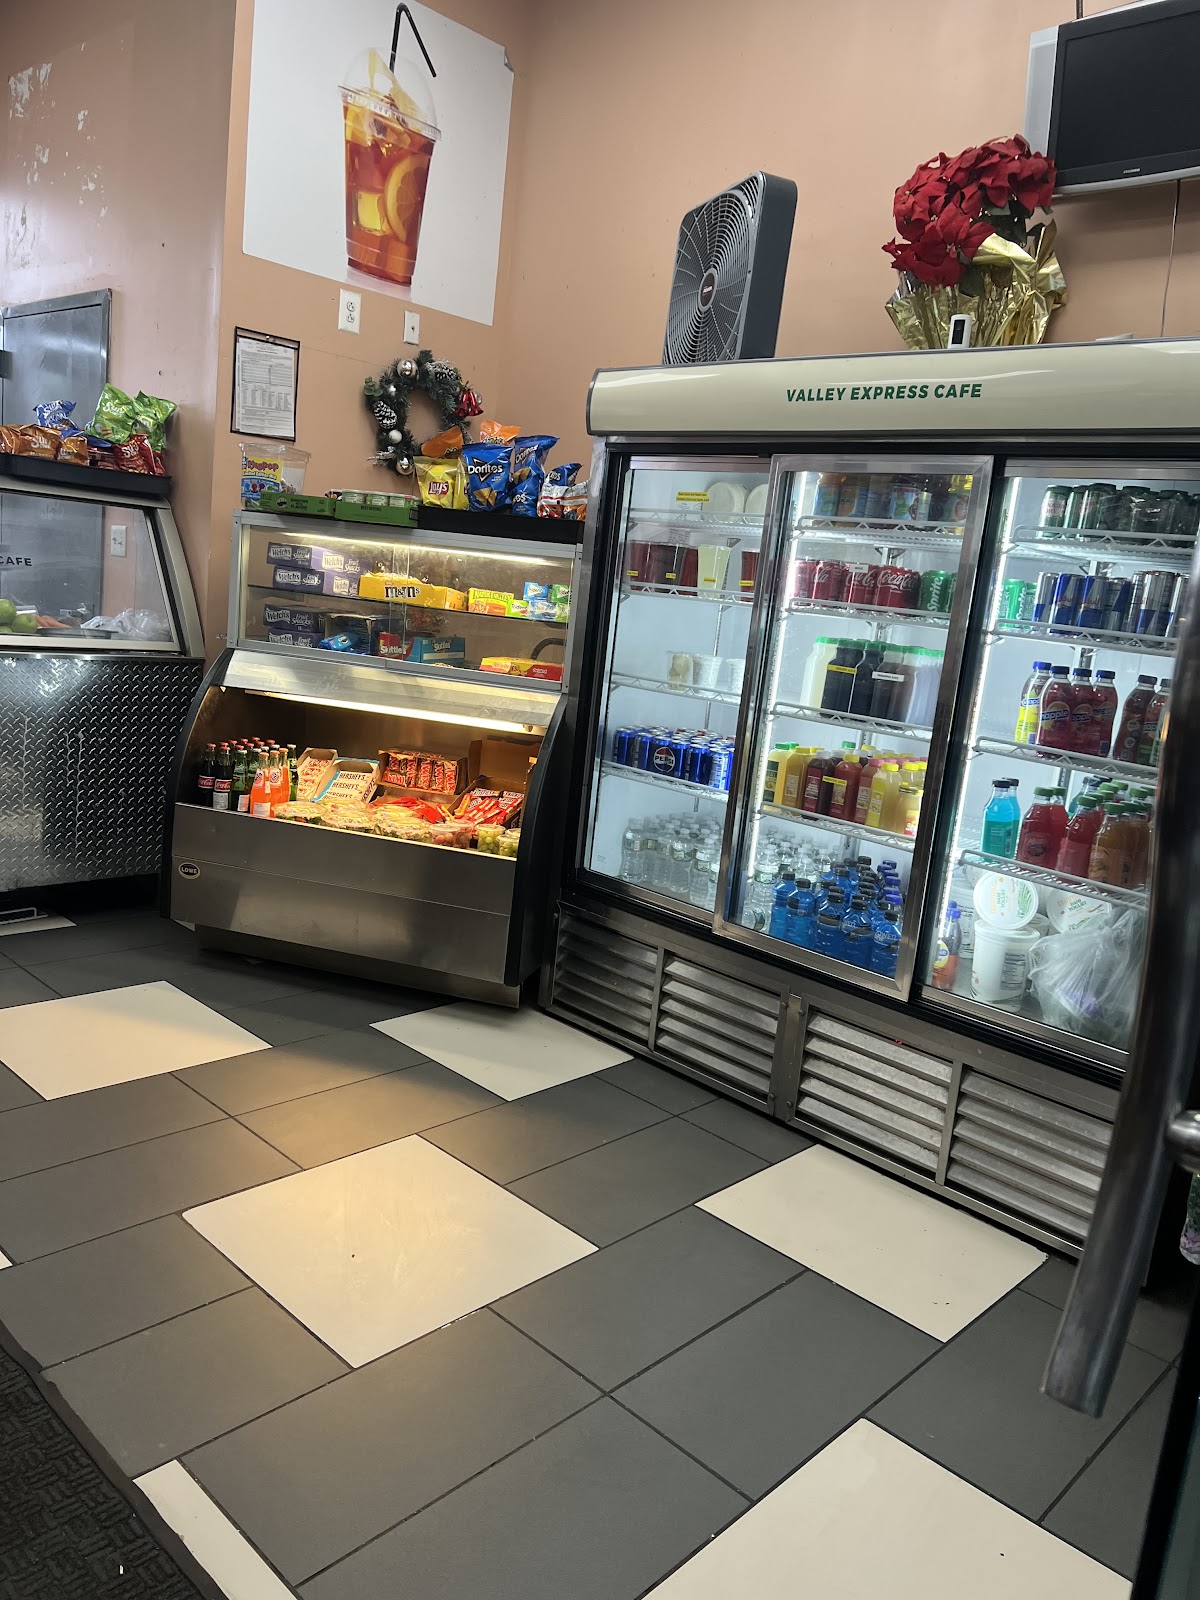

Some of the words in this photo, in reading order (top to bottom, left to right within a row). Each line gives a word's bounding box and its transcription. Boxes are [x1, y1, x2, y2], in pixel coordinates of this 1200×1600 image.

[786, 388, 846, 402] VALLEY
[850, 385, 930, 401] EXPRESS
[933, 383, 982, 399] CAFE
[467, 464, 503, 475] Doritos
[926, 576, 943, 612] Sprite
[267, 611, 290, 621] Welch's
[380, 645, 407, 654] Skittles
[1041, 709, 1069, 721] napple
[655, 756, 673, 765] PEPSI
[332, 782, 359, 790] HERSHEY'S
